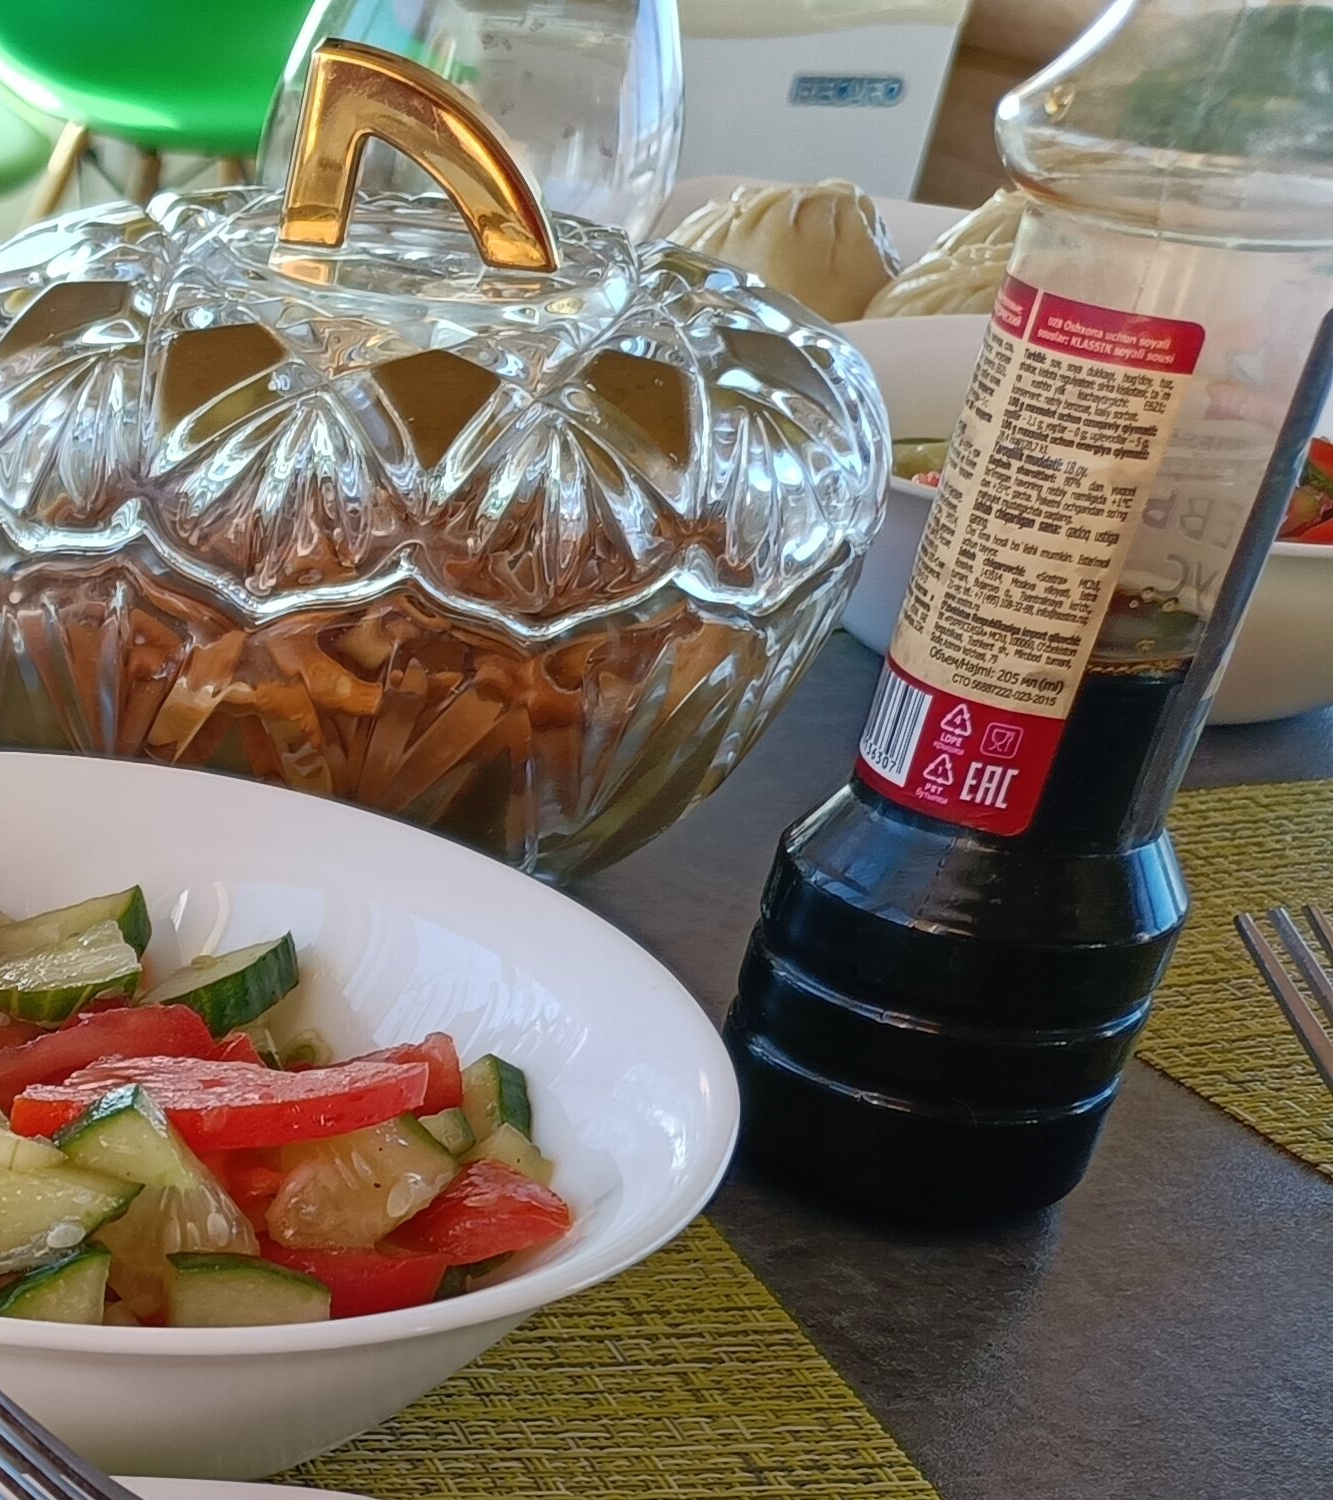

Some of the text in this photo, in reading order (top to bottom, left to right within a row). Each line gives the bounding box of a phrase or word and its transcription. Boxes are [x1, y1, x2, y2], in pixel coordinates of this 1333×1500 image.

[1063, 320, 1104, 339] Oshxona
[1105, 331, 1137, 346] uchun
[1138, 334, 1172, 350] soyali
[1113, 345, 1145, 361] soyali
[1145, 352, 1176, 364] sousi
[1064, 459, 1075, 474] 18
[929, 646, 1065, 695] Объем/Hajmi: 205 мл (ml)
[924, 782, 944, 794] PET
